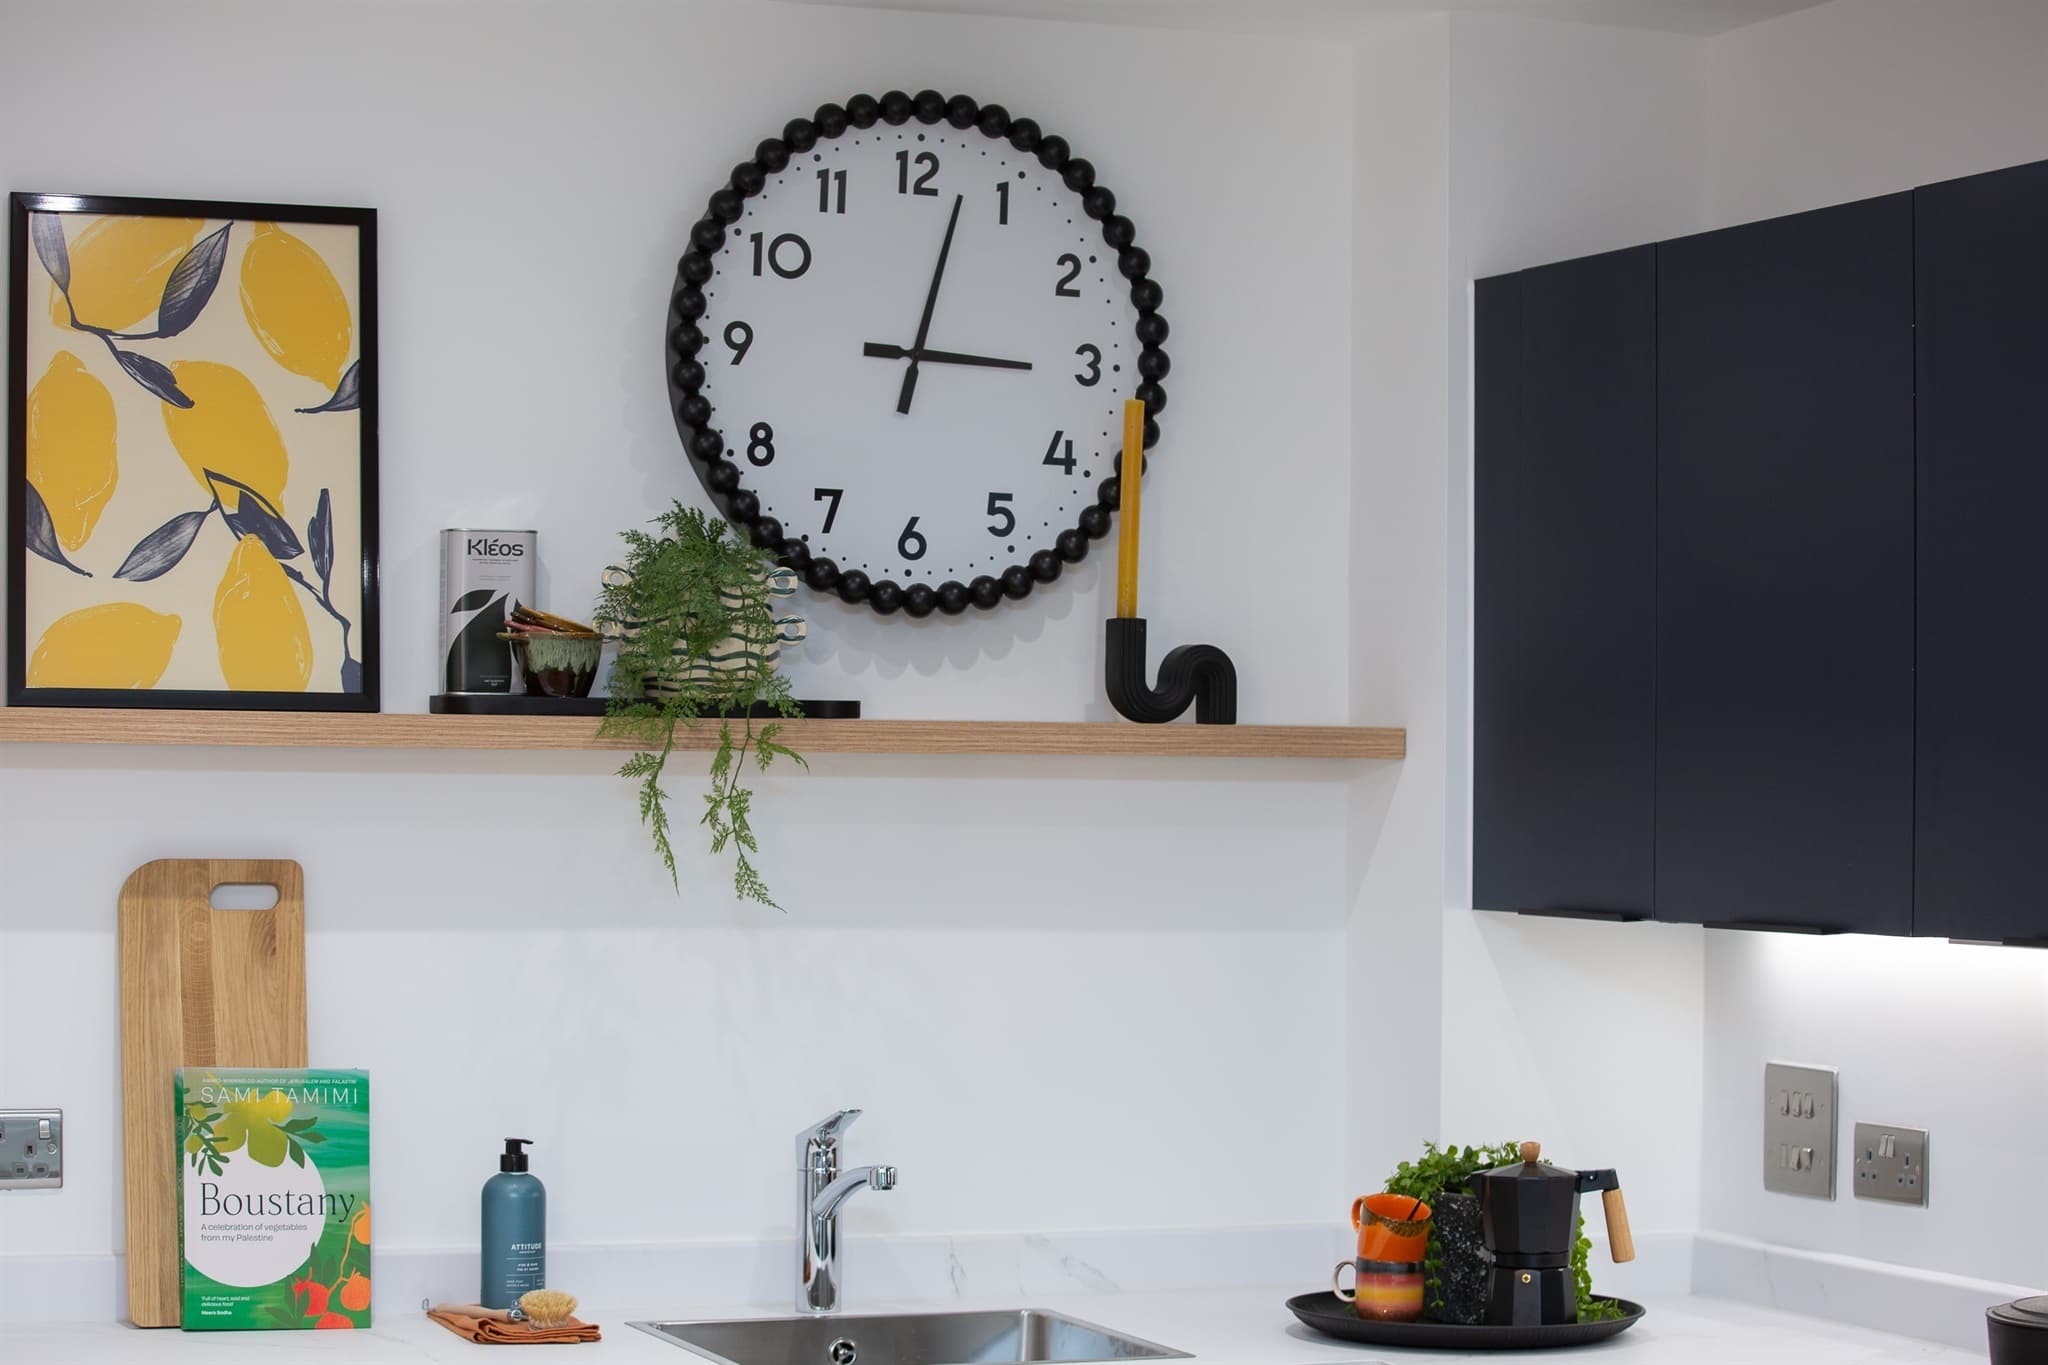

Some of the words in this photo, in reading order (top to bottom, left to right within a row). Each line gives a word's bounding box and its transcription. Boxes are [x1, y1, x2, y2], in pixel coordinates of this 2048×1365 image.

[816, 167, 848, 215] 11
[895, 149, 941, 198] 12
[995, 180, 1010, 226] 1
[749, 231, 812, 280] 10
[1055, 252, 1082, 298] 2
[722, 320, 754, 366] 9
[1073, 342, 1102, 388] 3
[746, 421, 776, 468] 8
[1041, 430, 1078, 476] 4
[813, 487, 844, 535] 7
[986, 491, 1016, 538] 5
[467, 538, 524, 557] Kléos
[897, 516, 928, 561] 6
[200, 1086, 260, 1104] SAMI
[271, 1087, 357, 1105] TAMIMI
[200, 1182, 355, 1223] Boustany
[200, 1234, 221, 1242] from
[221, 1235, 235, 1243] my
[236, 1234, 273, 1242] Palestine
[207, 1223, 254, 1231] celebration
[254, 1223, 264, 1231] of
[264, 1223, 308, 1232] vegetables
